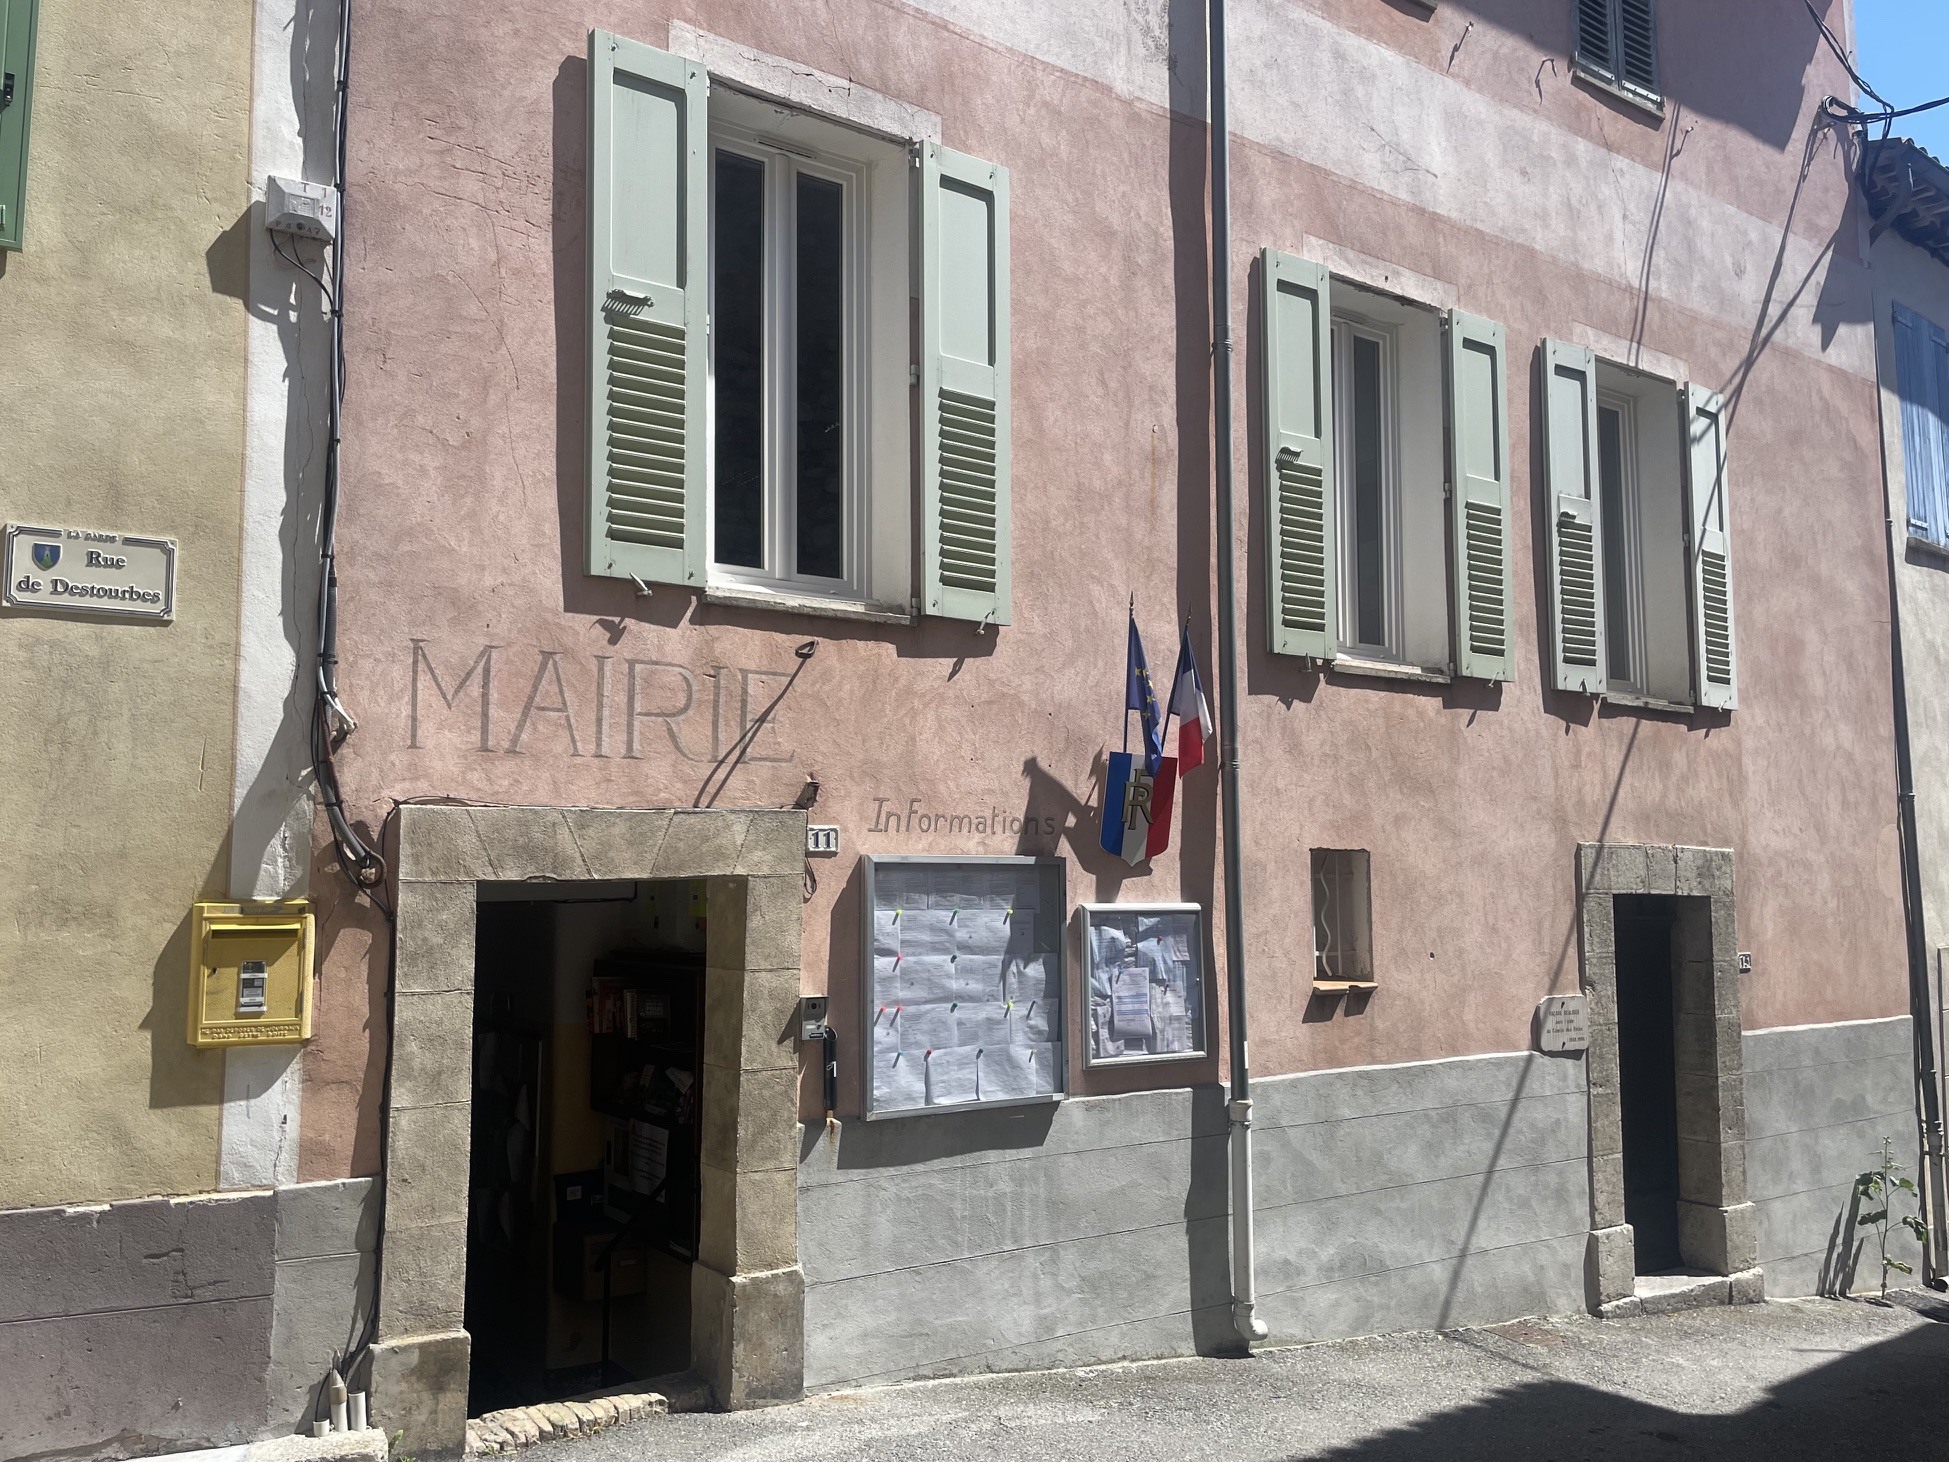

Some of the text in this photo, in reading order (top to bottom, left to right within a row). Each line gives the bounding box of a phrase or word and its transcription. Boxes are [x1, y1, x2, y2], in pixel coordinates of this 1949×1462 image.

[319, 204, 332, 218] 12
[86, 549, 127, 569] Rue
[17, 574, 162, 602] de Destourbes
[407, 637, 797, 763] MAIRIE
[810, 829, 834, 850] 11
